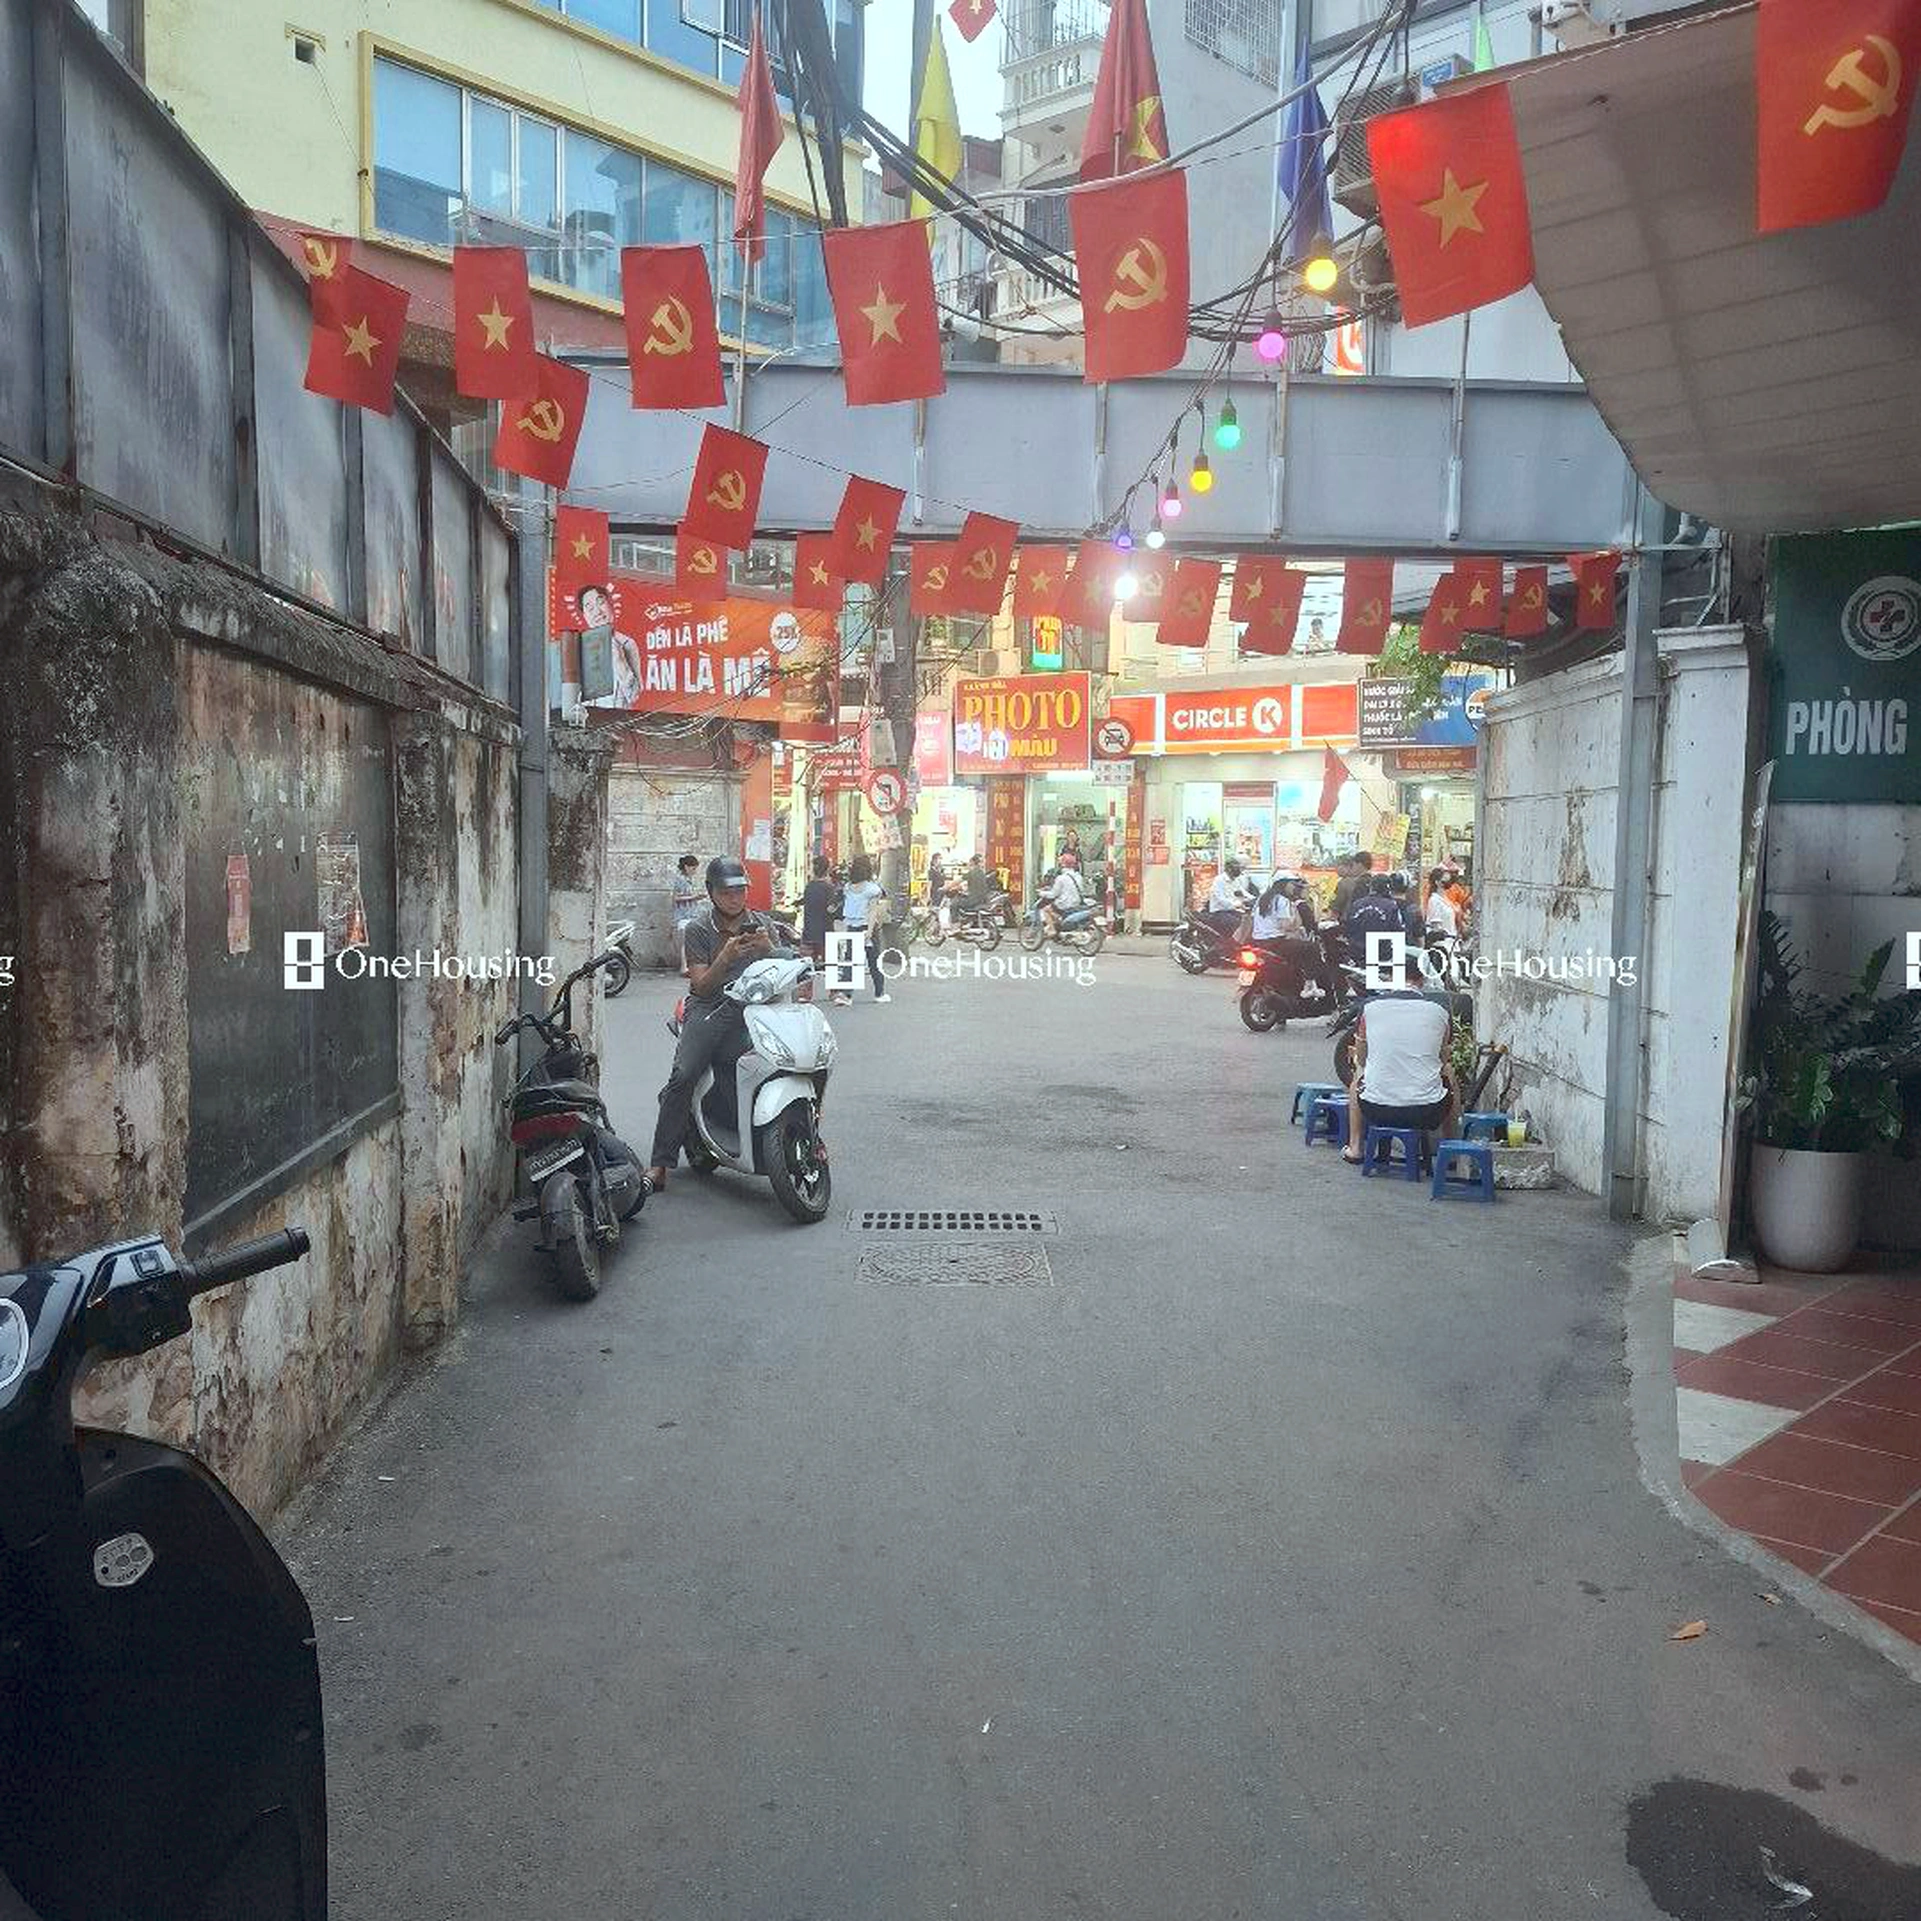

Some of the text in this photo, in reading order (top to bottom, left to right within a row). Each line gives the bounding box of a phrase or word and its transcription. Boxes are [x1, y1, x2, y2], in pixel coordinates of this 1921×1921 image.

[675, 622, 693, 647] LÀ
[696, 615, 729, 645] PHÊ
[645, 647, 771, 698] ĂN LÀ MÊ
[962, 688, 1082, 733] PHOTO
[1172, 704, 1278, 731] CIRCLE K
[1785, 685, 1908, 755] PHÒNG
[1009, 734, 1058, 757] MÀU
